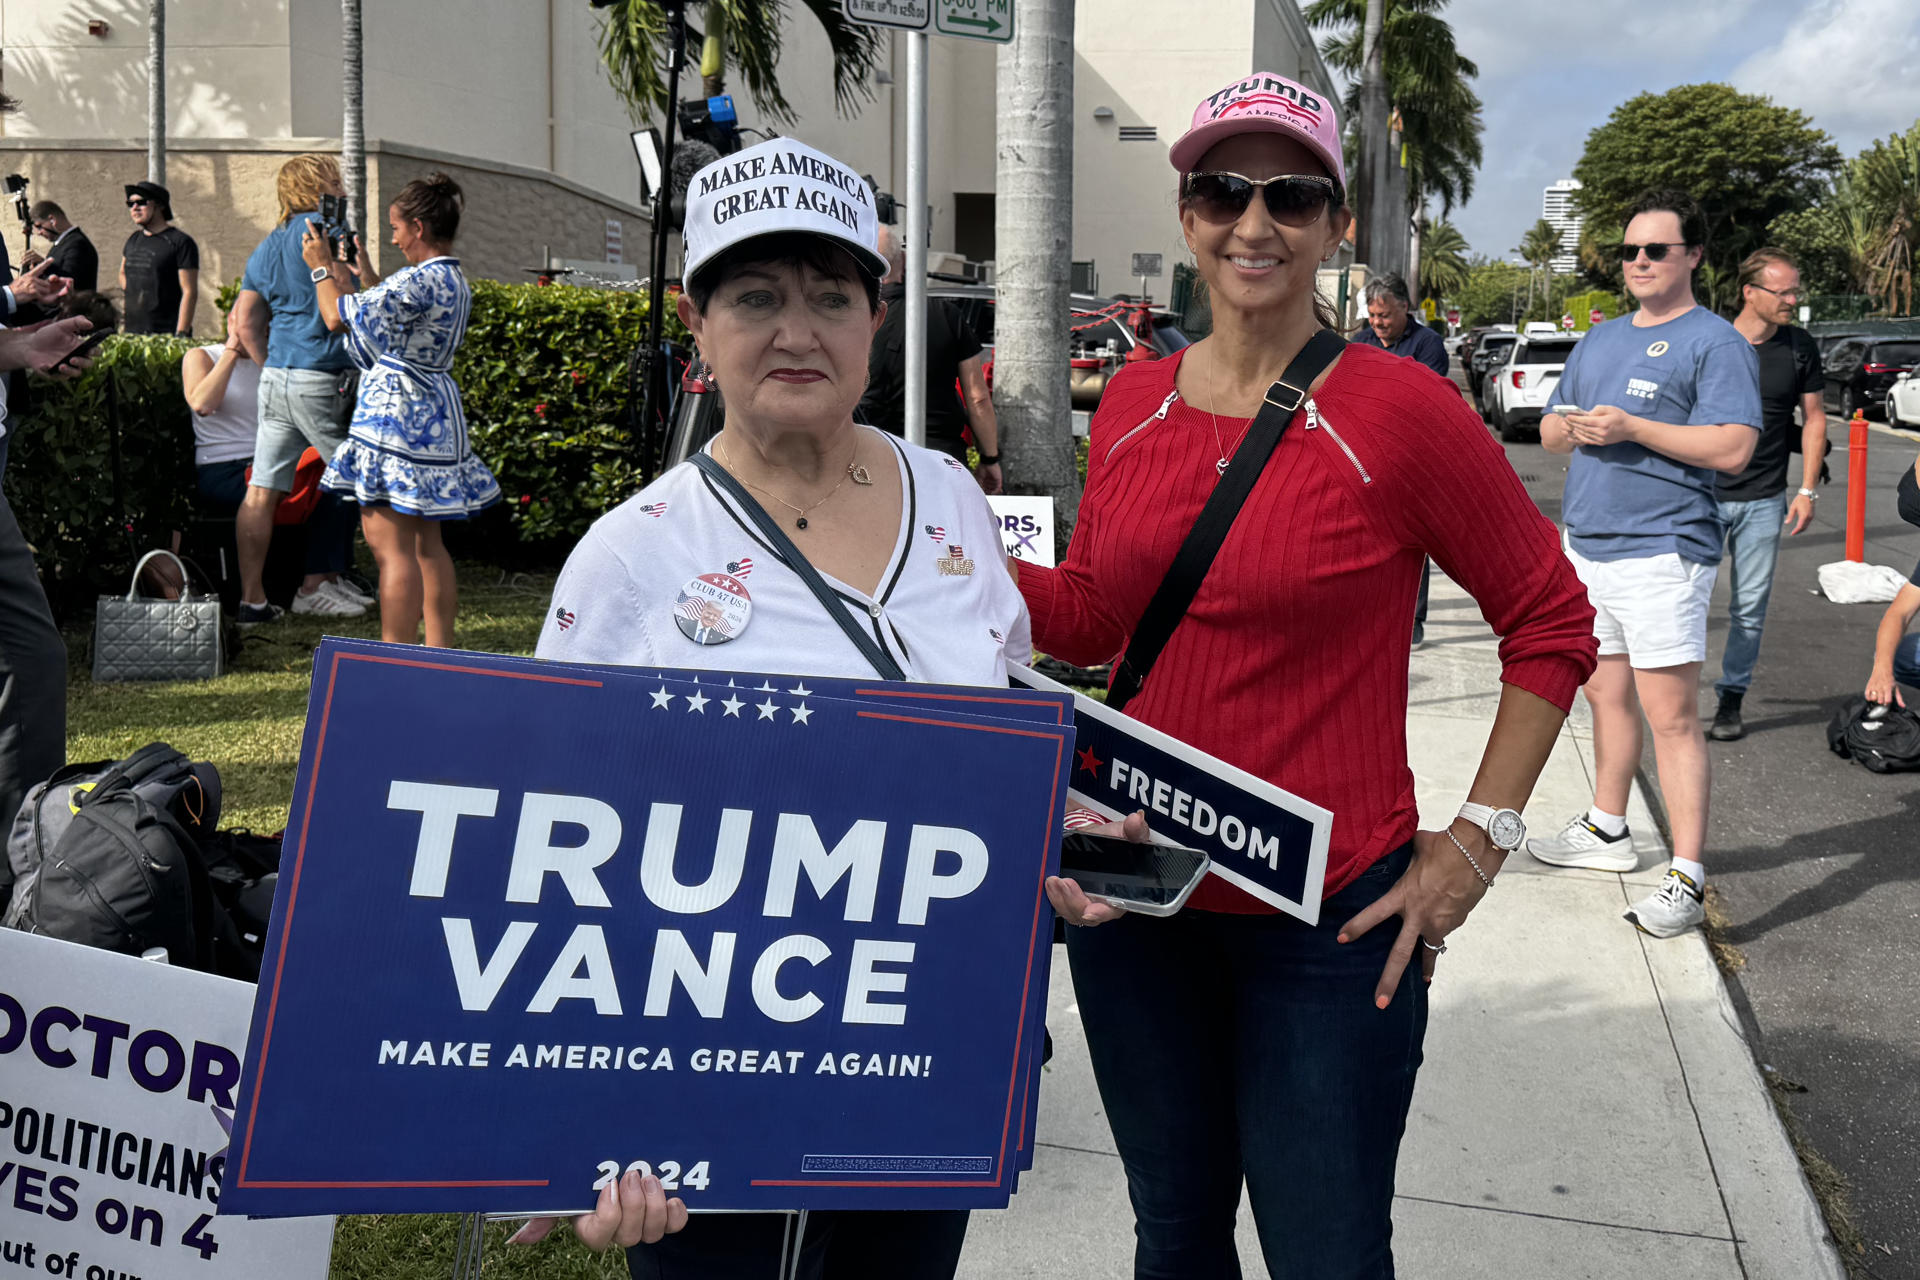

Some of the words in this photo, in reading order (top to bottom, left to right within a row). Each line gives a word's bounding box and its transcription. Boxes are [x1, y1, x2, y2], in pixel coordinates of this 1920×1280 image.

[861, 1, 875, 12] FINE
[987, 0, 1008, 14] PM
[1207, 77, 1321, 112] Trump
[699, 156, 766, 197] MAKE
[770, 152, 869, 207] AMERICA
[714, 186, 789, 225] GREAT
[795, 187, 859, 234] AGAIN
[1625, 388, 1655, 399] 2024
[937, 557, 975, 576] TRUMP
[691, 580, 715, 597] CLUB
[716, 590, 729, 601] 47
[730, 597, 748, 614] USA
[1110, 757, 1280, 871] FREEDOM
[387, 781, 988, 925] TRUMP
[442, 918, 915, 1024] VANCE
[379, 1041, 491, 1067] MAKE
[505, 1044, 674, 1071] AMERICA
[691, 1048, 804, 1074] GREAT
[815, 1053, 932, 1078] AGAIN!
[95, 1198, 164, 1247] on
[181, 1213, 219, 1261] 4
[0, 1240, 36, 1269] ut
[45, 1252, 80, 1280] of
